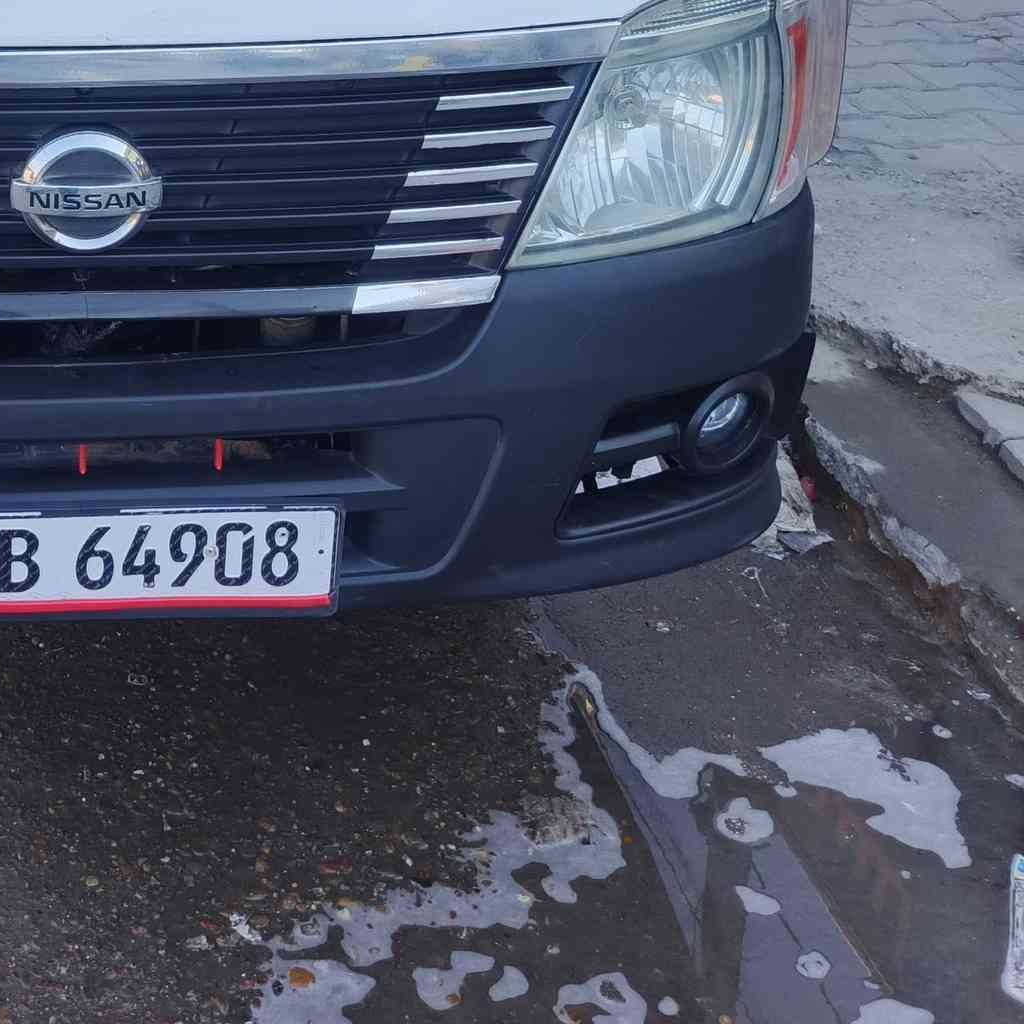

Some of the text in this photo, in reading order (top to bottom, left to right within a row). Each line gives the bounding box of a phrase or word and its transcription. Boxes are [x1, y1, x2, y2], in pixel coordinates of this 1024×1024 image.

[29, 190, 147, 210] NISSAN
[0, 529, 41, 593] B
[75, 521, 300, 591] 64908
